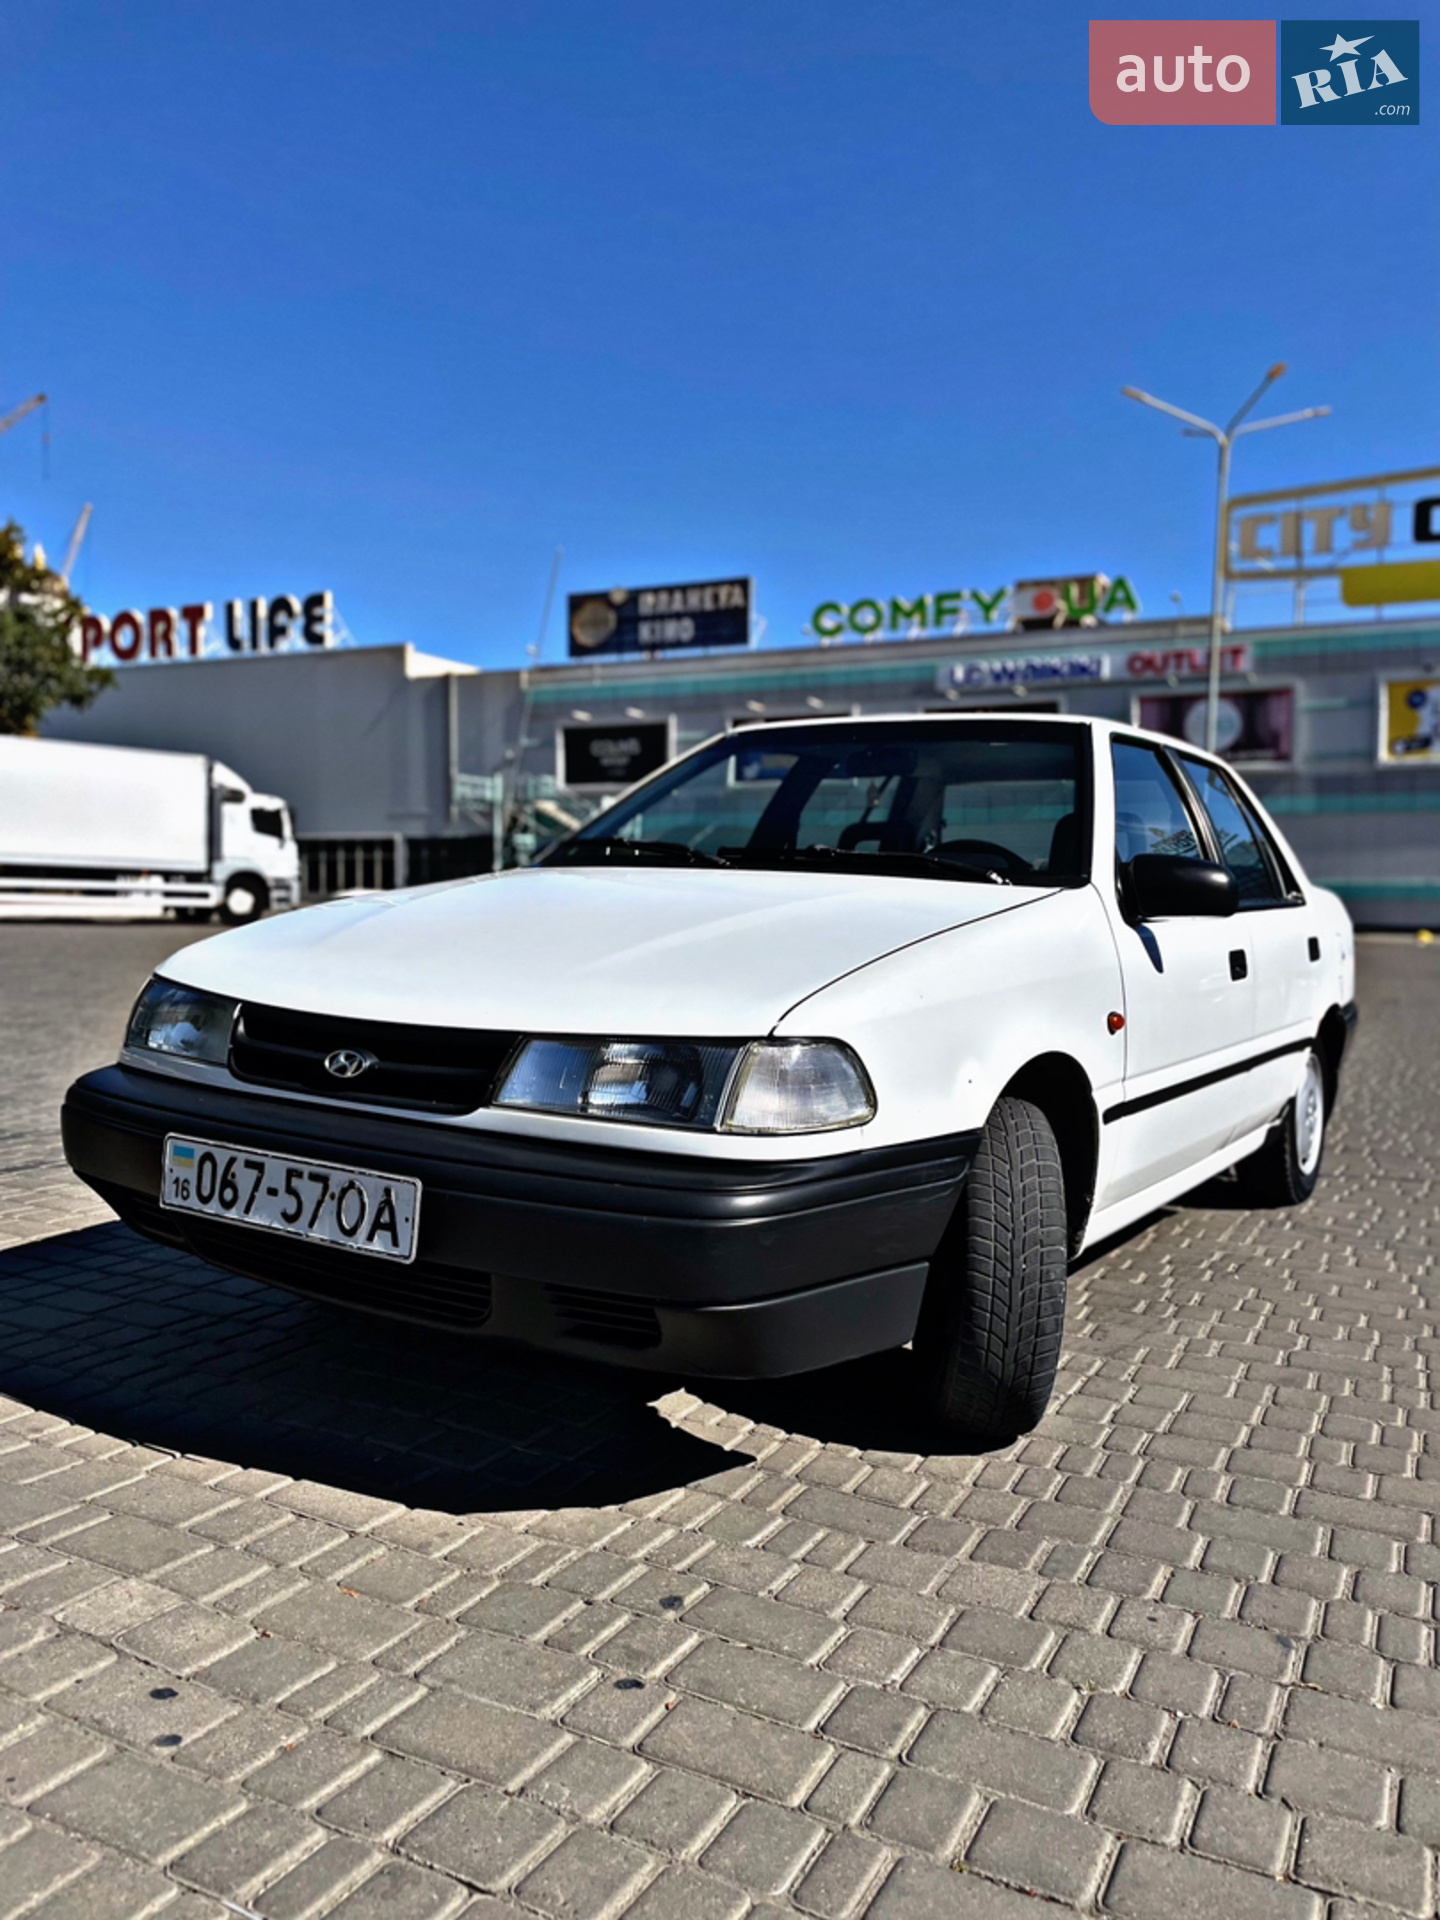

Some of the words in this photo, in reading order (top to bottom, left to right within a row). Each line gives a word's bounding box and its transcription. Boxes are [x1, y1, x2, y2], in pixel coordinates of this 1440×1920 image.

[1240, 502, 1392, 560] CITY
[64, 602, 207, 667] PORT
[226, 591, 331, 651] LIFE
[812, 588, 1008, 638] COMFY
[172, 1176, 190, 1200] 16
